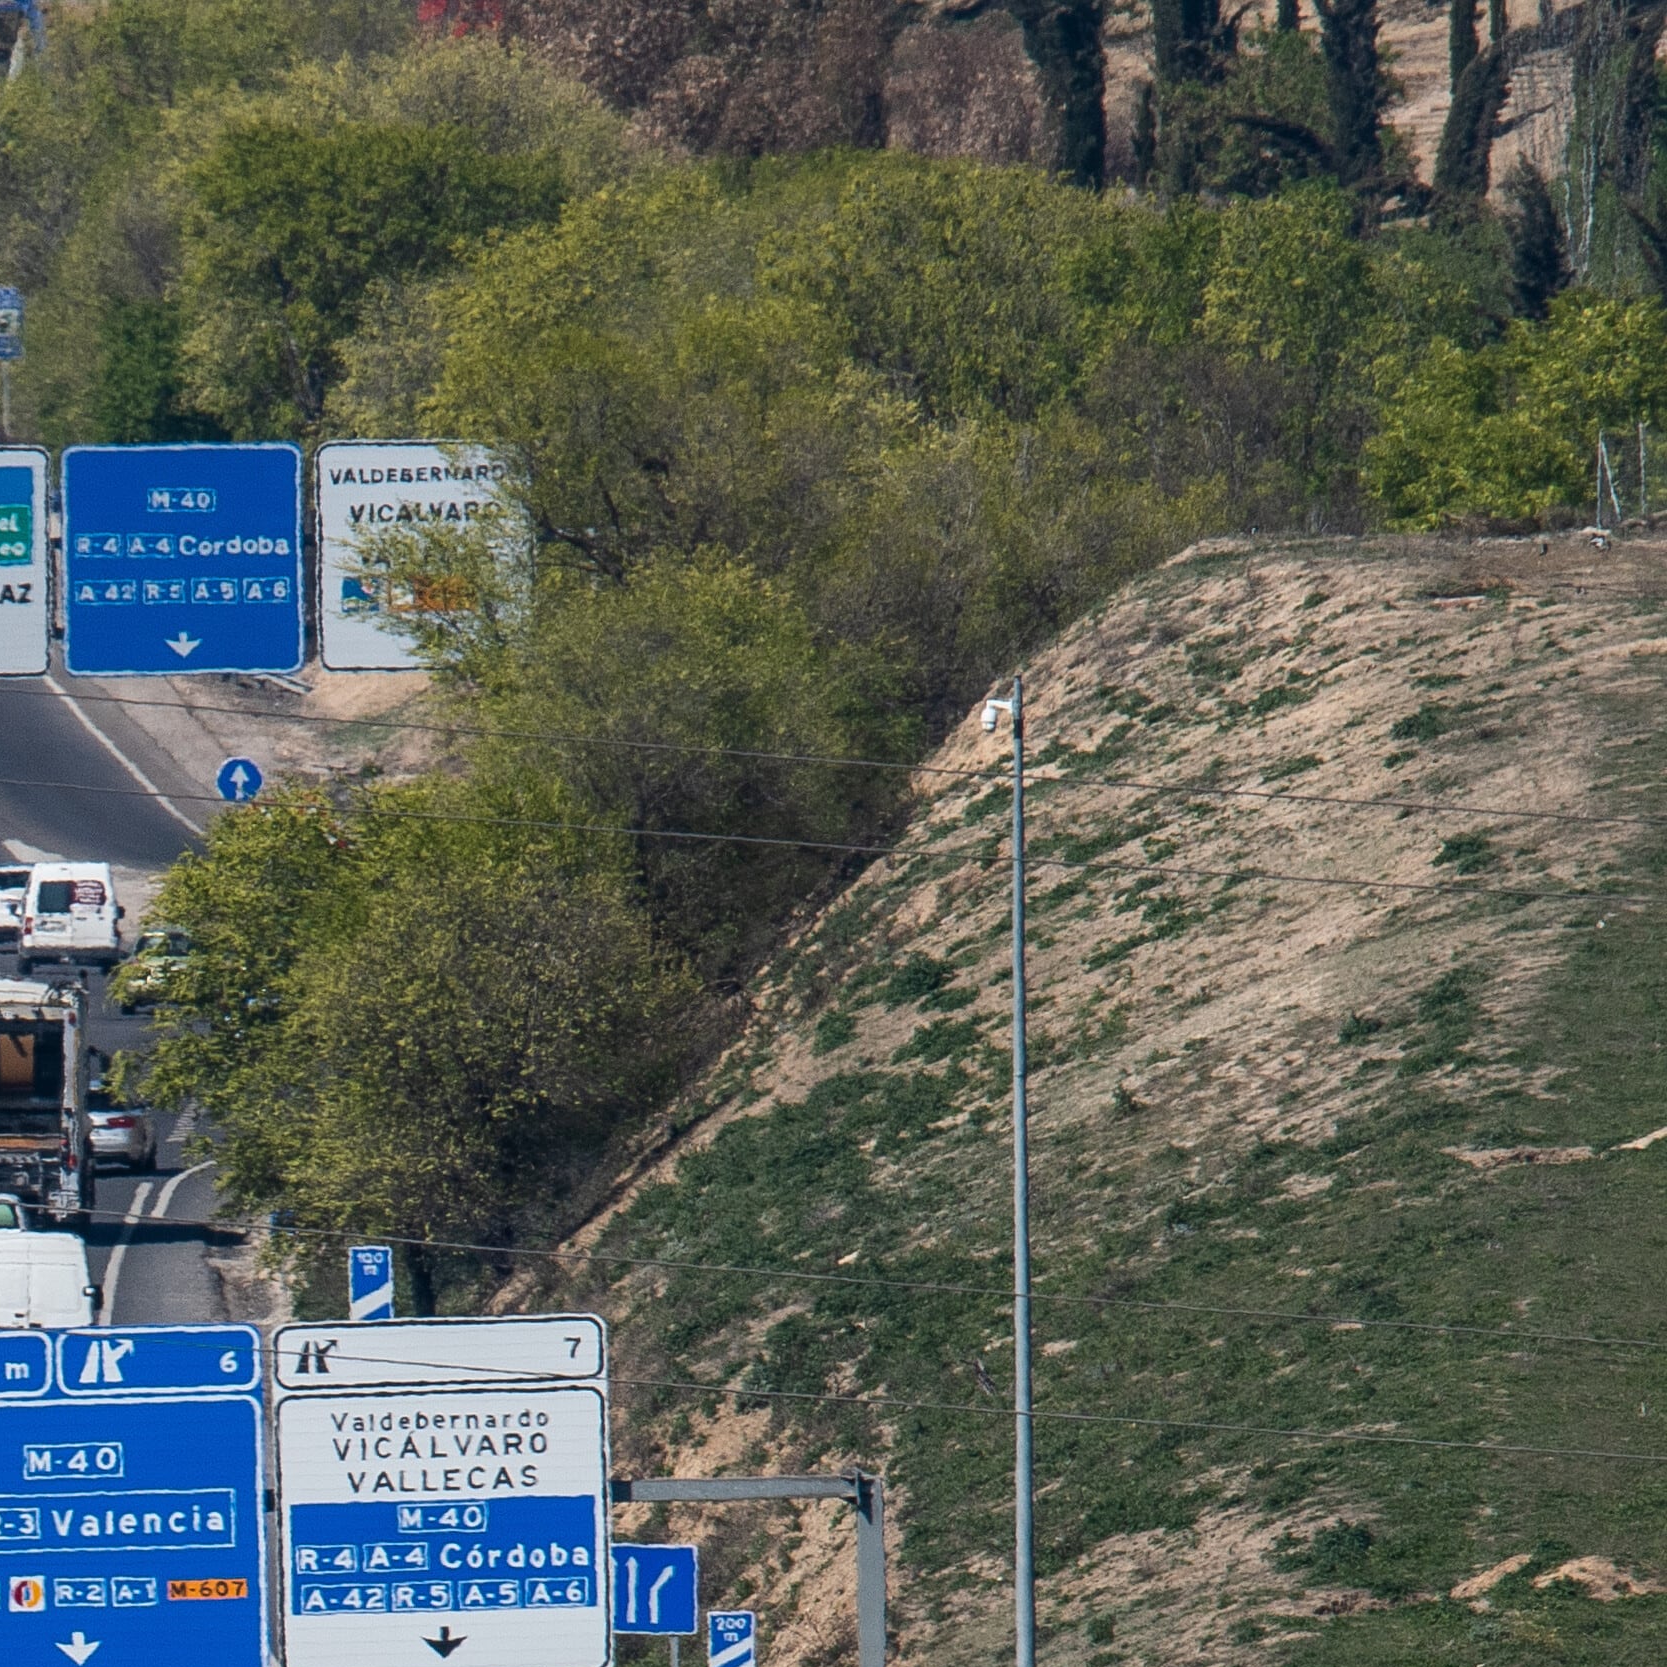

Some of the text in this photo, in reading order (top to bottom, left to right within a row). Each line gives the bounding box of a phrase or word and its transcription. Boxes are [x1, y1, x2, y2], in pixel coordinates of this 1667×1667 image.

[151, 491, 210, 508] M-40
[77, 535, 289, 555] R-4 A-4 Córdoba
[79, 584, 134, 600] A-42
[195, 582, 234, 599] A-5
[248, 581, 287, 598] A-6
[356, 1252, 384, 1263] 100
[565, 1337, 582, 1359] 7
[5, 1361, 29, 1379] m
[219, 1350, 238, 1375] 6
[331, 1408, 549, 1433] Valdebernardo
[333, 1429, 549, 1462] VICÁLVARO
[28, 1448, 117, 1473] M-40
[348, 1465, 539, 1494] VALLECAS
[51, 1506, 225, 1538] Valencia
[399, 1506, 483, 1529] M-40
[298, 1543, 589, 1570] R-4 A-4 Córdoba
[57, 1581, 102, 1604] R-2
[115, 1580, 155, 1602] A-1
[169, 1579, 245, 1599] M-607
[305, 1581, 583, 1611] A-42 R-5 A-5 A-6
[715, 1617, 746, 1631] 200
[724, 1632, 738, 1642] m
